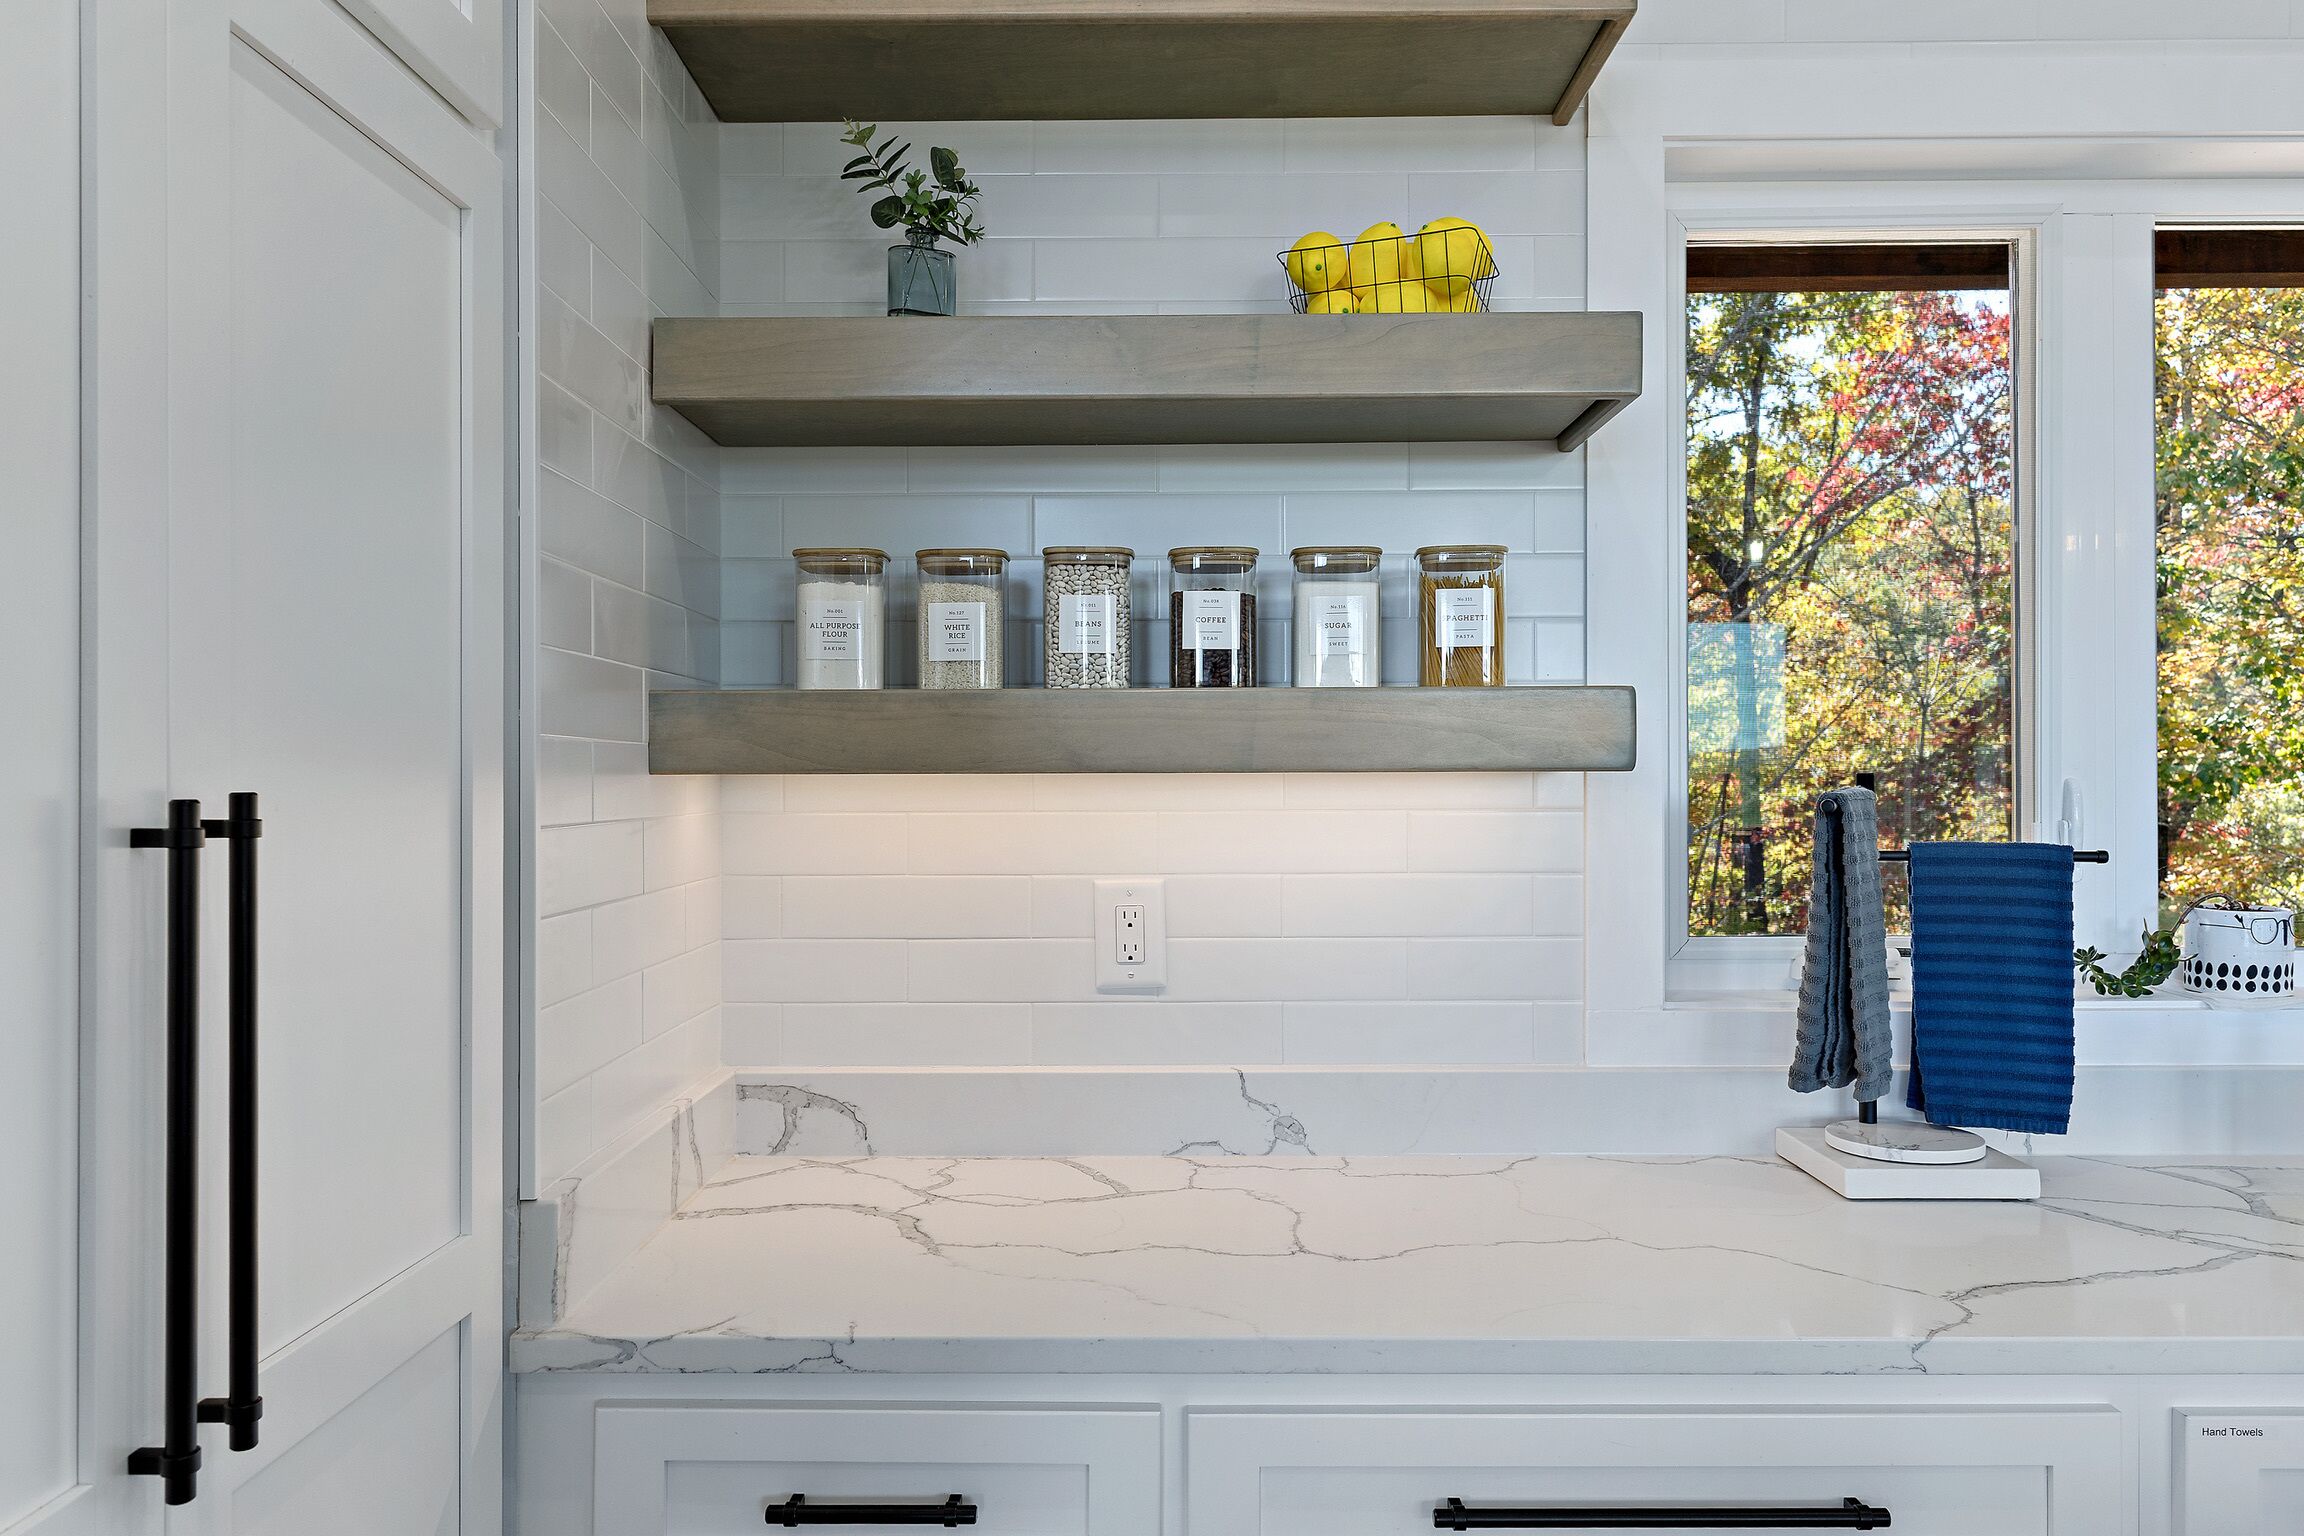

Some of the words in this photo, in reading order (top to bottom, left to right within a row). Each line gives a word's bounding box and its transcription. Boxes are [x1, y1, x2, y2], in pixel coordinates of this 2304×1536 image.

[1195, 616, 1227, 624] COFFEE
[1442, 614, 1489, 622] PAGHETTI
[826, 622, 861, 630] PURPOSE
[822, 630, 848, 638] FLOUR
[2202, 1427, 2227, 1437] Hand
[2229, 1427, 2264, 1437] Towels
